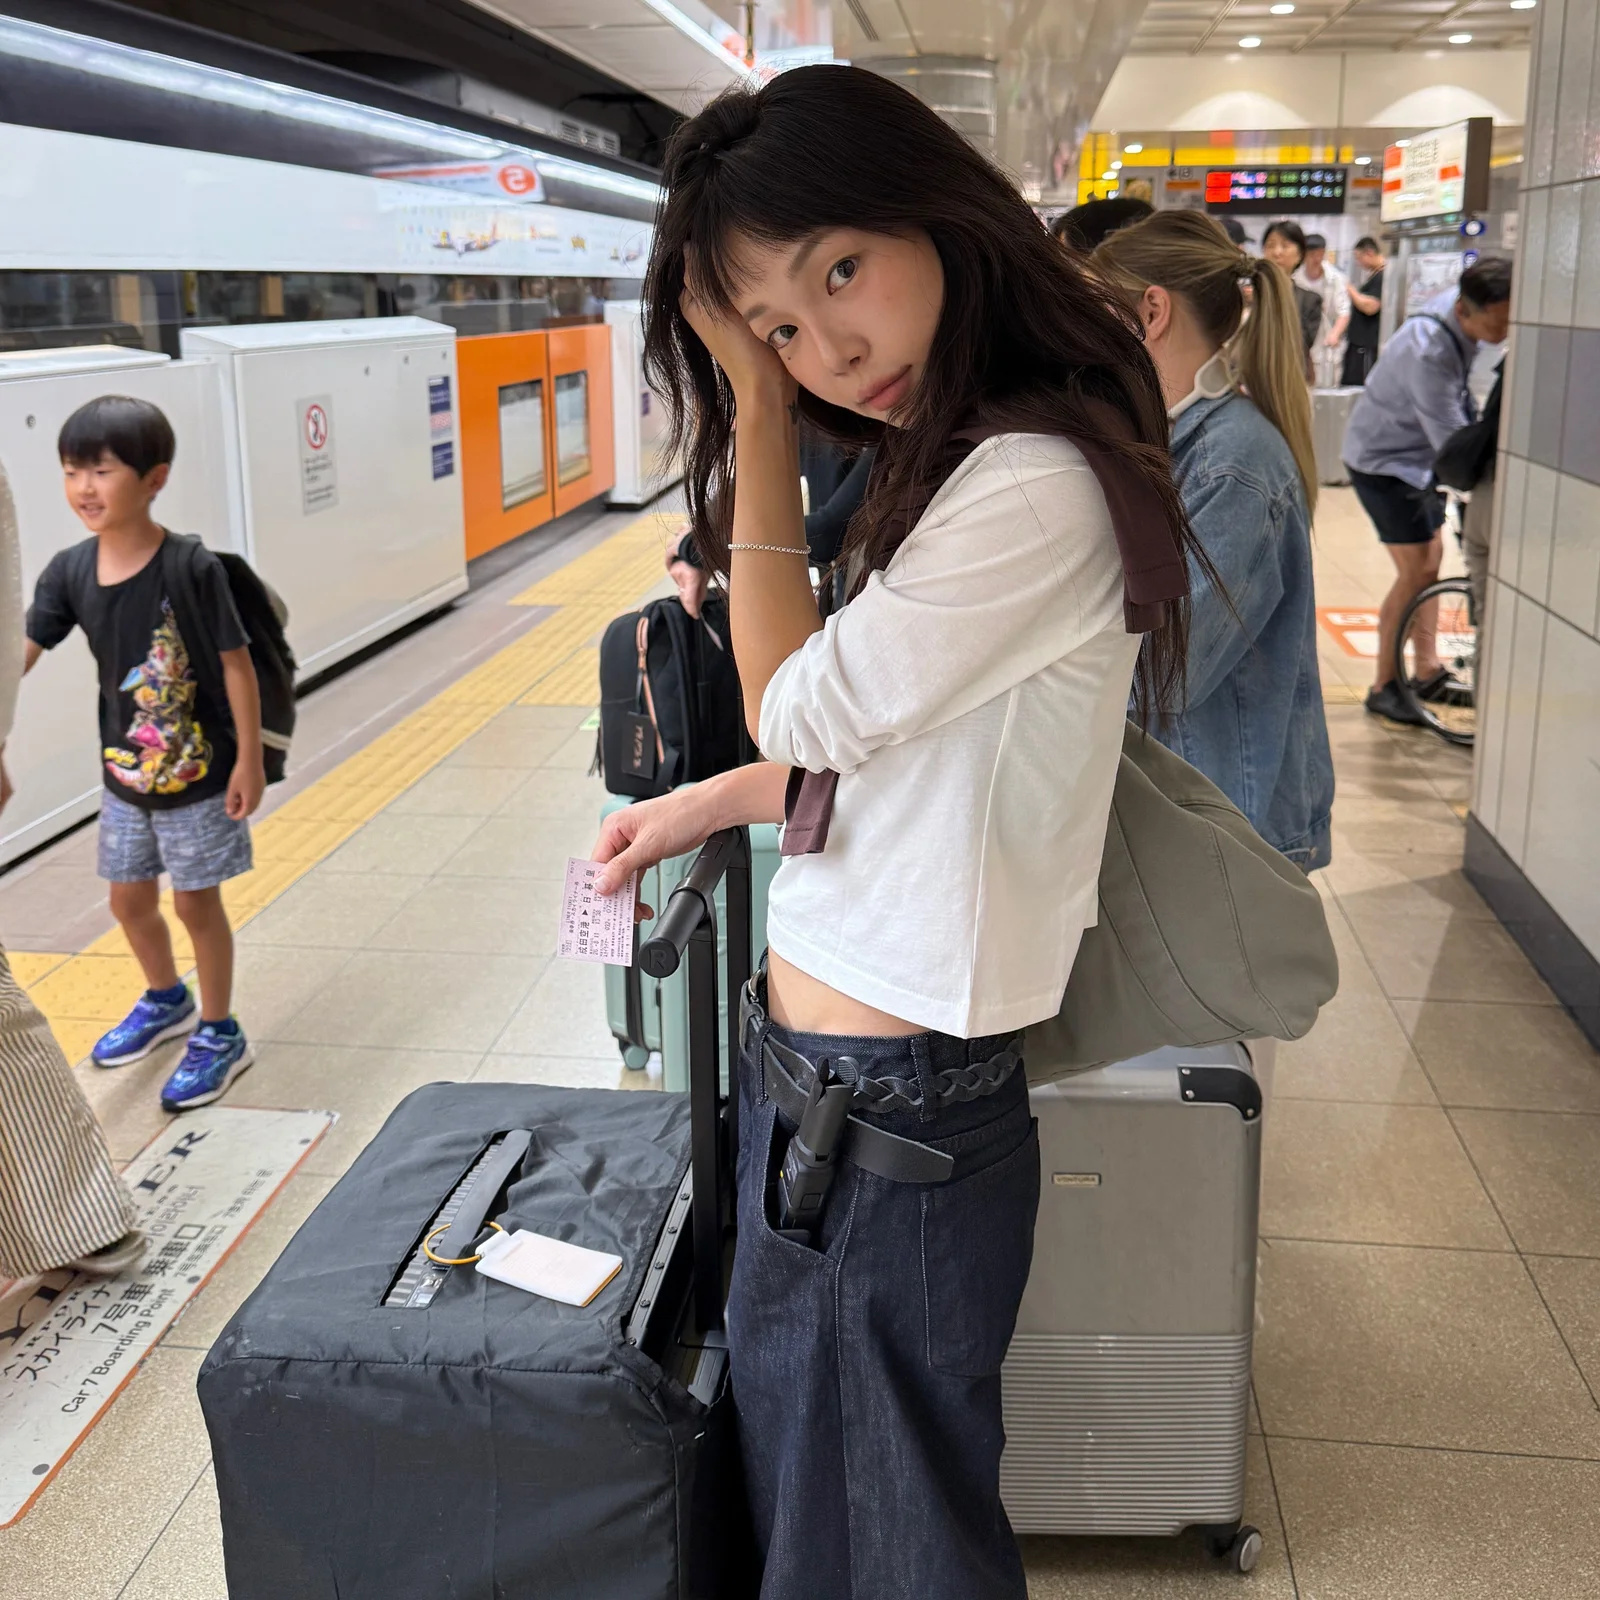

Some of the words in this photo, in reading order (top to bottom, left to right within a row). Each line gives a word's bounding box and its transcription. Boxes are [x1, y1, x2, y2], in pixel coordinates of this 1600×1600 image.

[648, 949, 667, 970] R
[91, 1283, 155, 1334] 7号車
[141, 1223, 206, 1277] 乗車口
[61, 1390, 90, 1413] Car
[81, 1378, 98, 1386] 7
[92, 1319, 151, 1376] Boarding
[139, 1288, 175, 1319] Point
